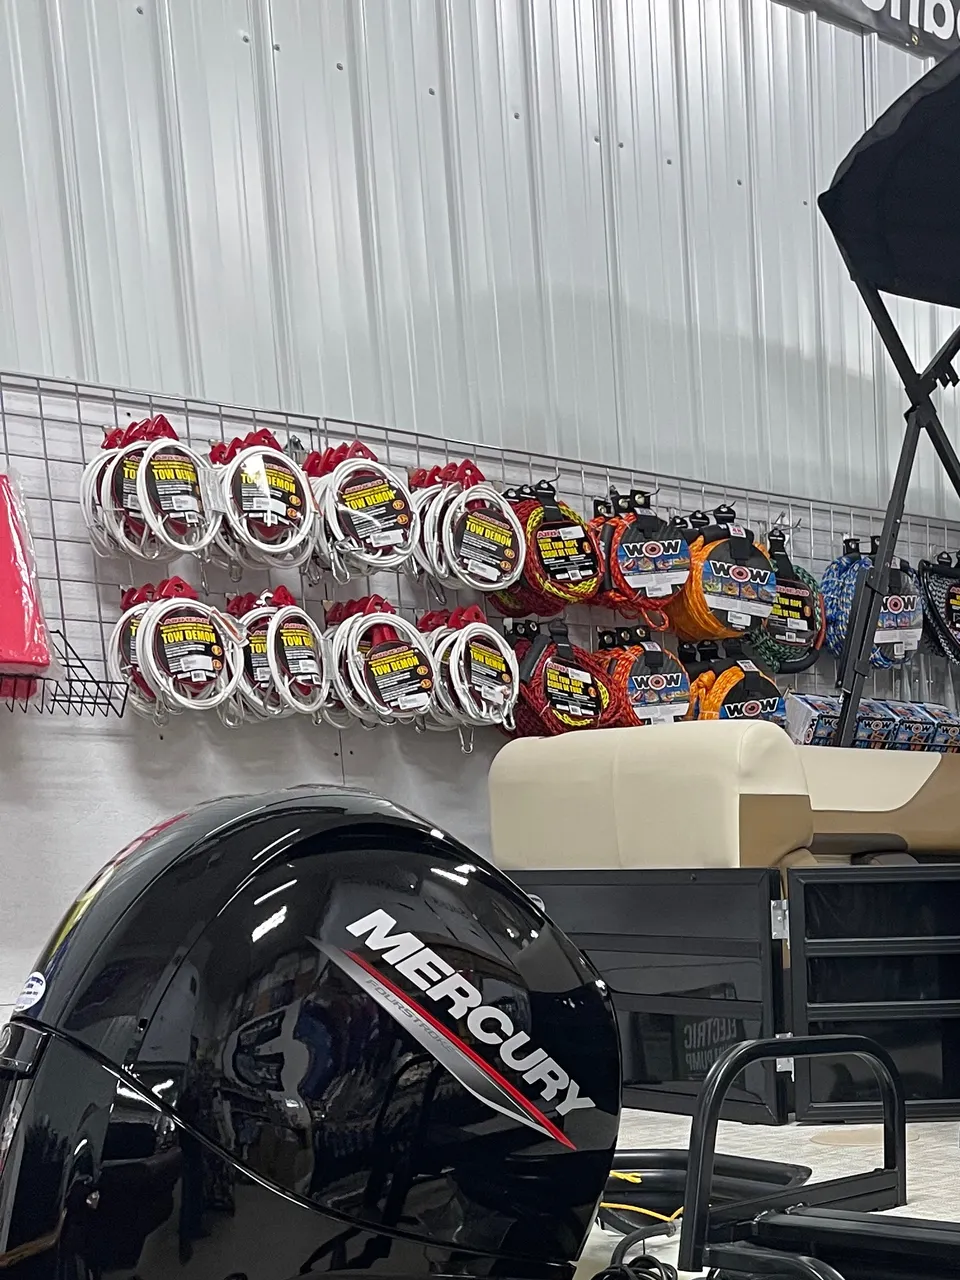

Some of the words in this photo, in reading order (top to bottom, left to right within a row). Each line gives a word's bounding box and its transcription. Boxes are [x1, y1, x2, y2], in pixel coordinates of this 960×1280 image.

[152, 469, 174, 480] TOW
[345, 498, 366, 510] TOW
[365, 489, 395, 506] DEMON
[466, 521, 484, 536] TOW
[484, 529, 512, 547] DEMON
[622, 539, 681, 557] WOW
[709, 560, 770, 585] WOW
[161, 630, 183, 644] TOW
[185, 630, 216, 643] DEMON
[281, 636, 302, 646] TOW
[371, 665, 390, 677] TOW
[390, 656, 419, 671] DEMON
[632, 673, 681, 690] WOW
[725, 697, 779, 718] WOW
[863, 719, 895, 731] WOW
[903, 722, 934, 734] WOW
[346, 908, 596, 1116] MERCURY
[364, 978, 456, 1051] FOURSTROKE
